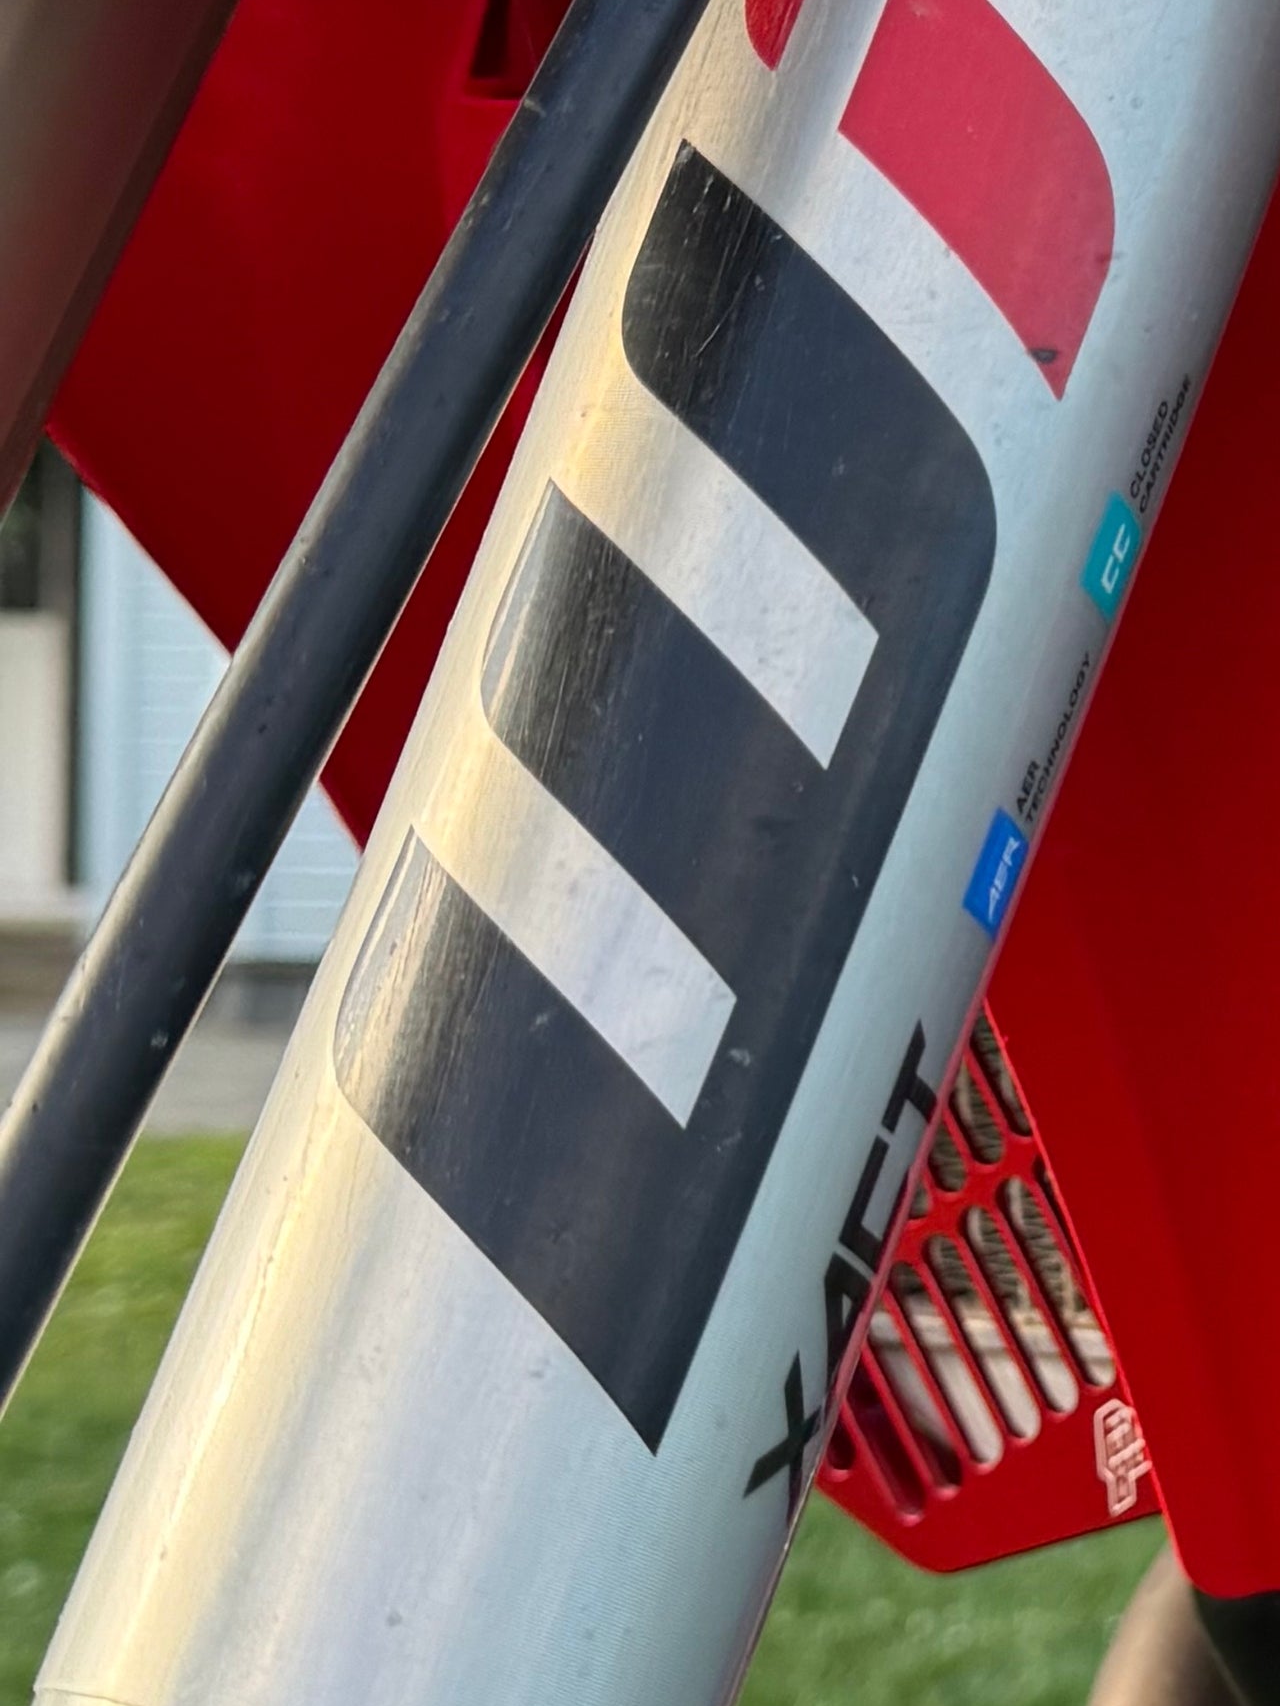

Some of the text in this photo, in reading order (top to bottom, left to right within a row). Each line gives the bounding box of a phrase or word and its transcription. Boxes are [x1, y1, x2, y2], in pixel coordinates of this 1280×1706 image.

[1130, 399, 1169, 500] CLOSED
[1100, 522, 1132, 596] CC
[1024, 651, 1092, 824] TECHNOLOGY
[1014, 758, 1040, 814] AER
[986, 834, 1021, 921] AER
